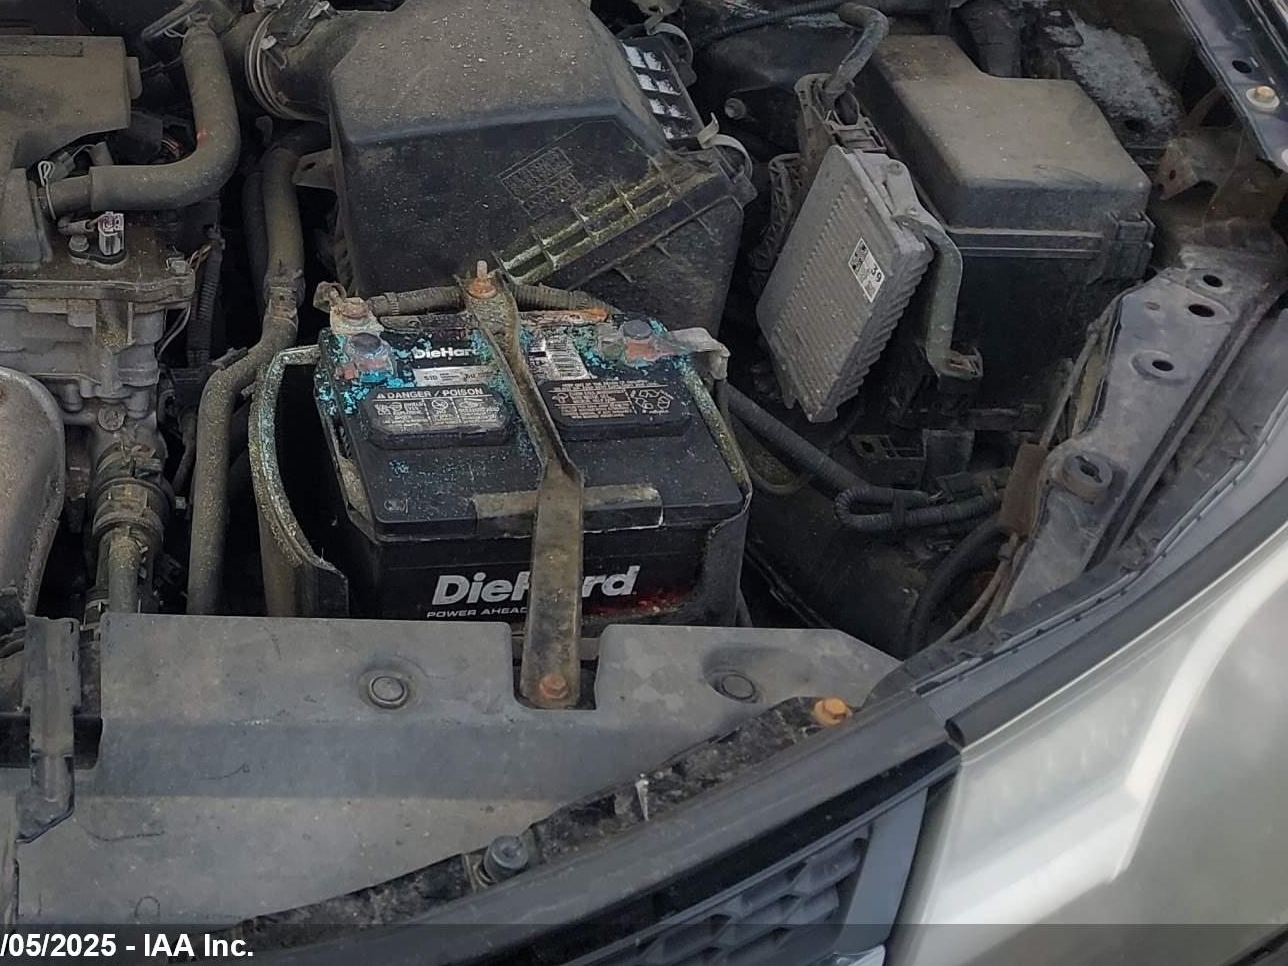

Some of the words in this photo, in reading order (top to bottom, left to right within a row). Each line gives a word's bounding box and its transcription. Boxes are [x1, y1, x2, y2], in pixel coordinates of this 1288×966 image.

[387, 390, 431, 400] DANGER
[442, 388, 484, 397] POISON
[431, 565, 641, 605] DieHrd
[426, 608, 477, 619] POWER
